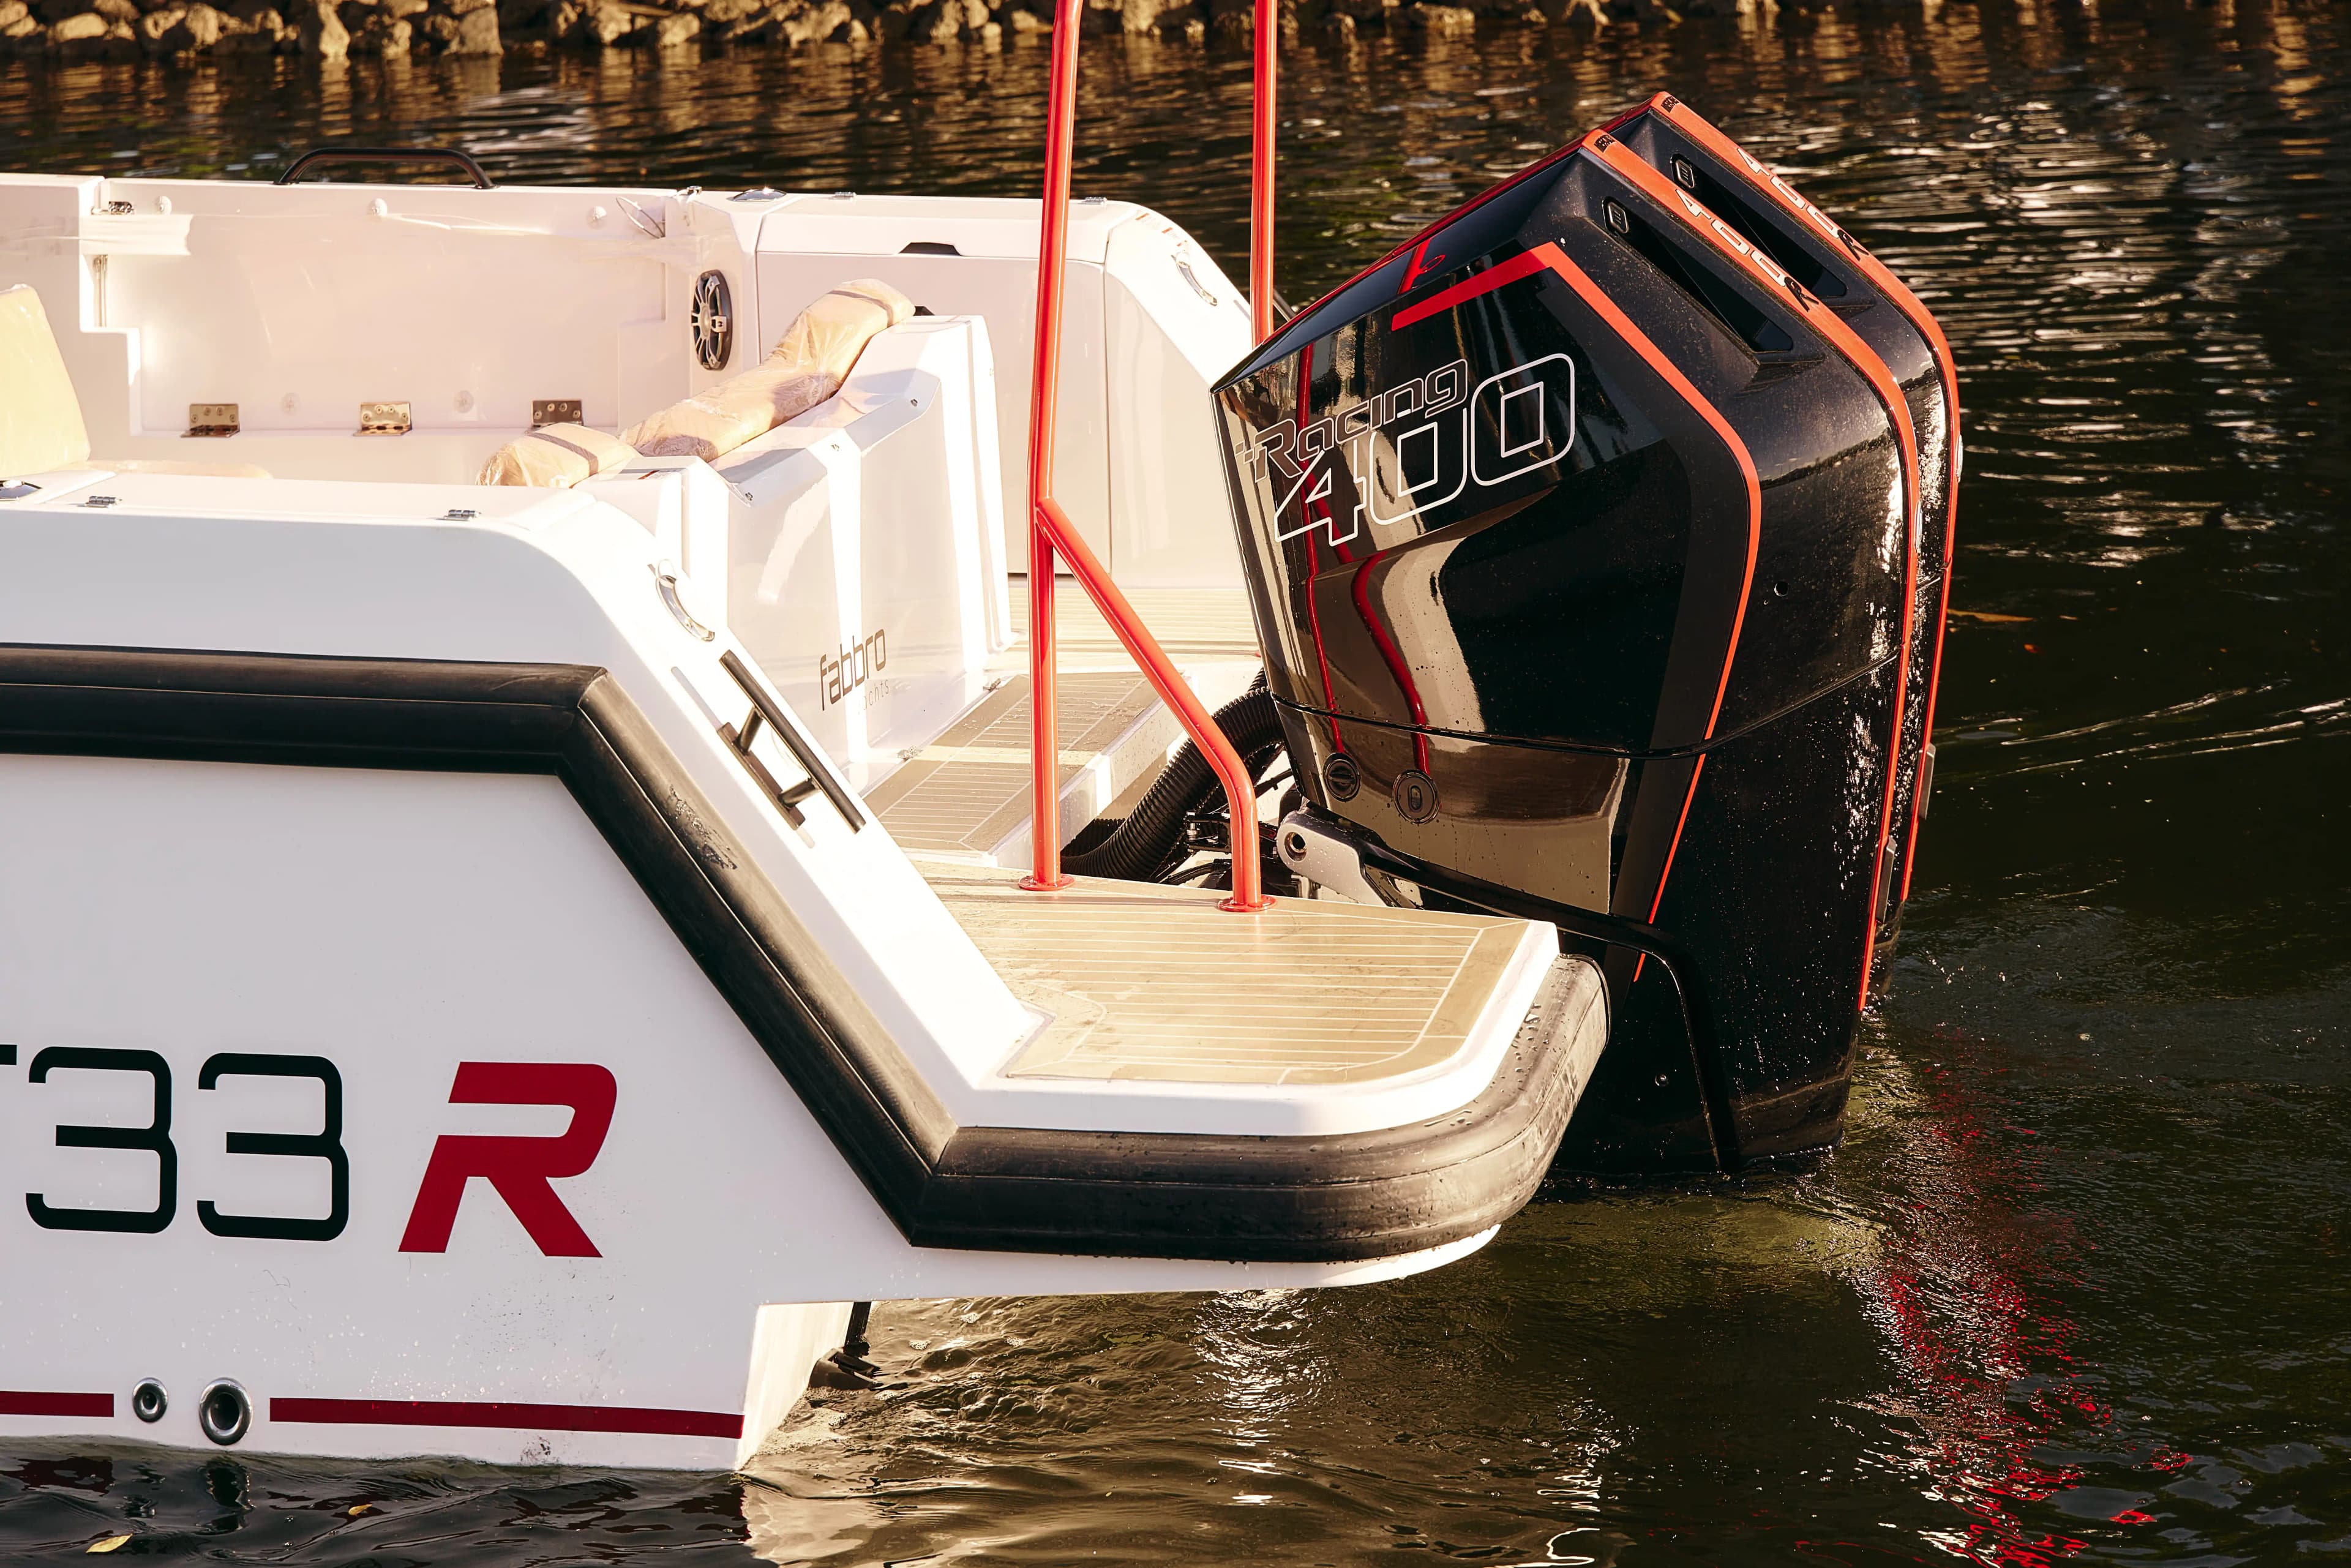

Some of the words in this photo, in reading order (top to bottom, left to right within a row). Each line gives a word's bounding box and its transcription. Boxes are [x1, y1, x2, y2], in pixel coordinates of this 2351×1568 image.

[1253, 358, 1468, 482] Racing
[1273, 353, 1575, 547] 400
[820, 628, 887, 711] fabbro
[857, 679, 890, 715] achts
[0, 1044, 350, 1242] 33
[398, 1061, 618, 1258] R
